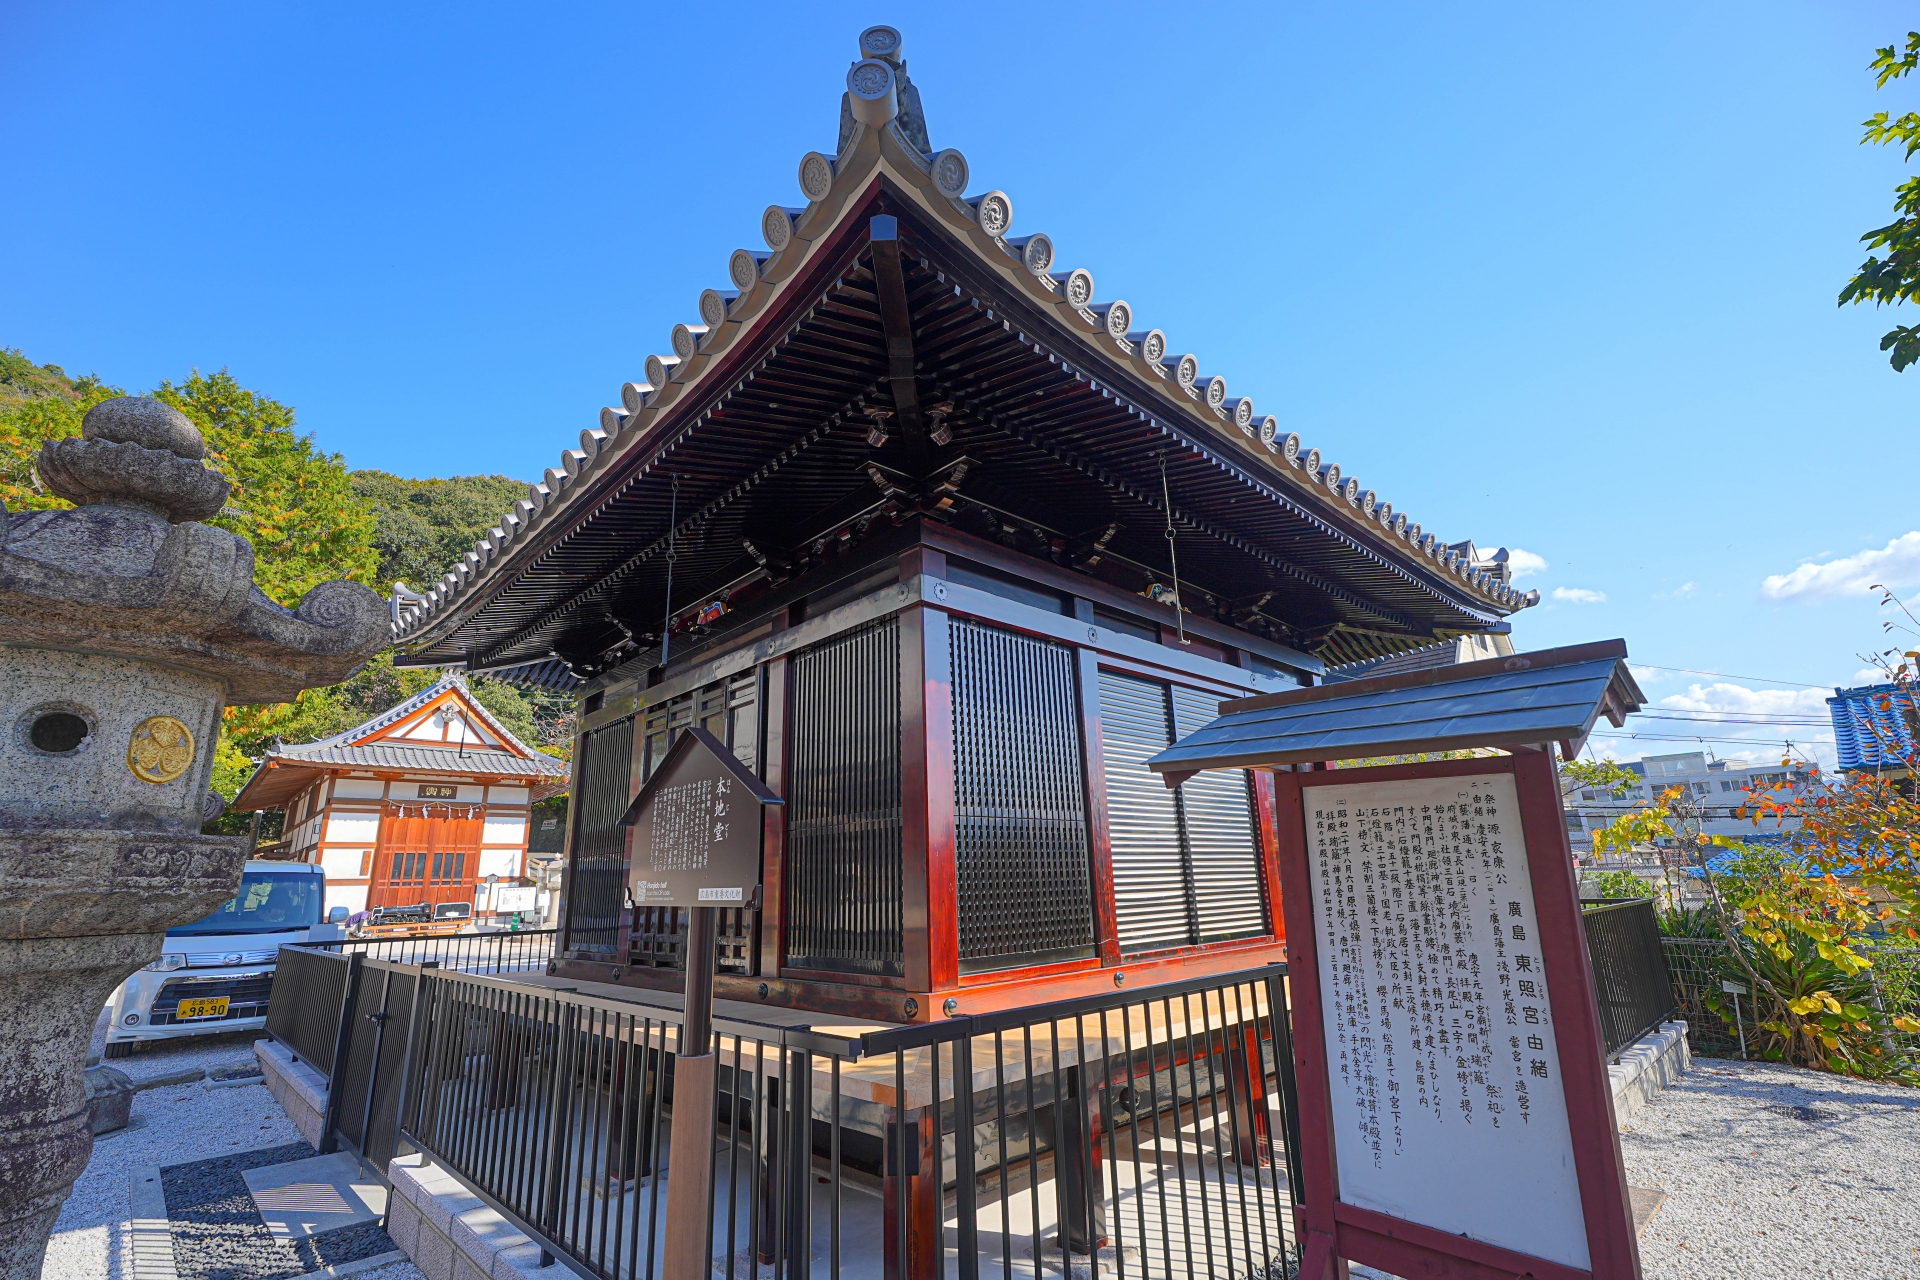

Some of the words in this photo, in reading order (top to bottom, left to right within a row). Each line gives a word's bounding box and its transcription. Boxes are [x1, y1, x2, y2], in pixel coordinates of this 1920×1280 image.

[714, 776, 726, 842] 本地堂
[189, 1005, 225, 1017] 98-90
[1506, 900, 1548, 1079] 廣島東照宮由緒
